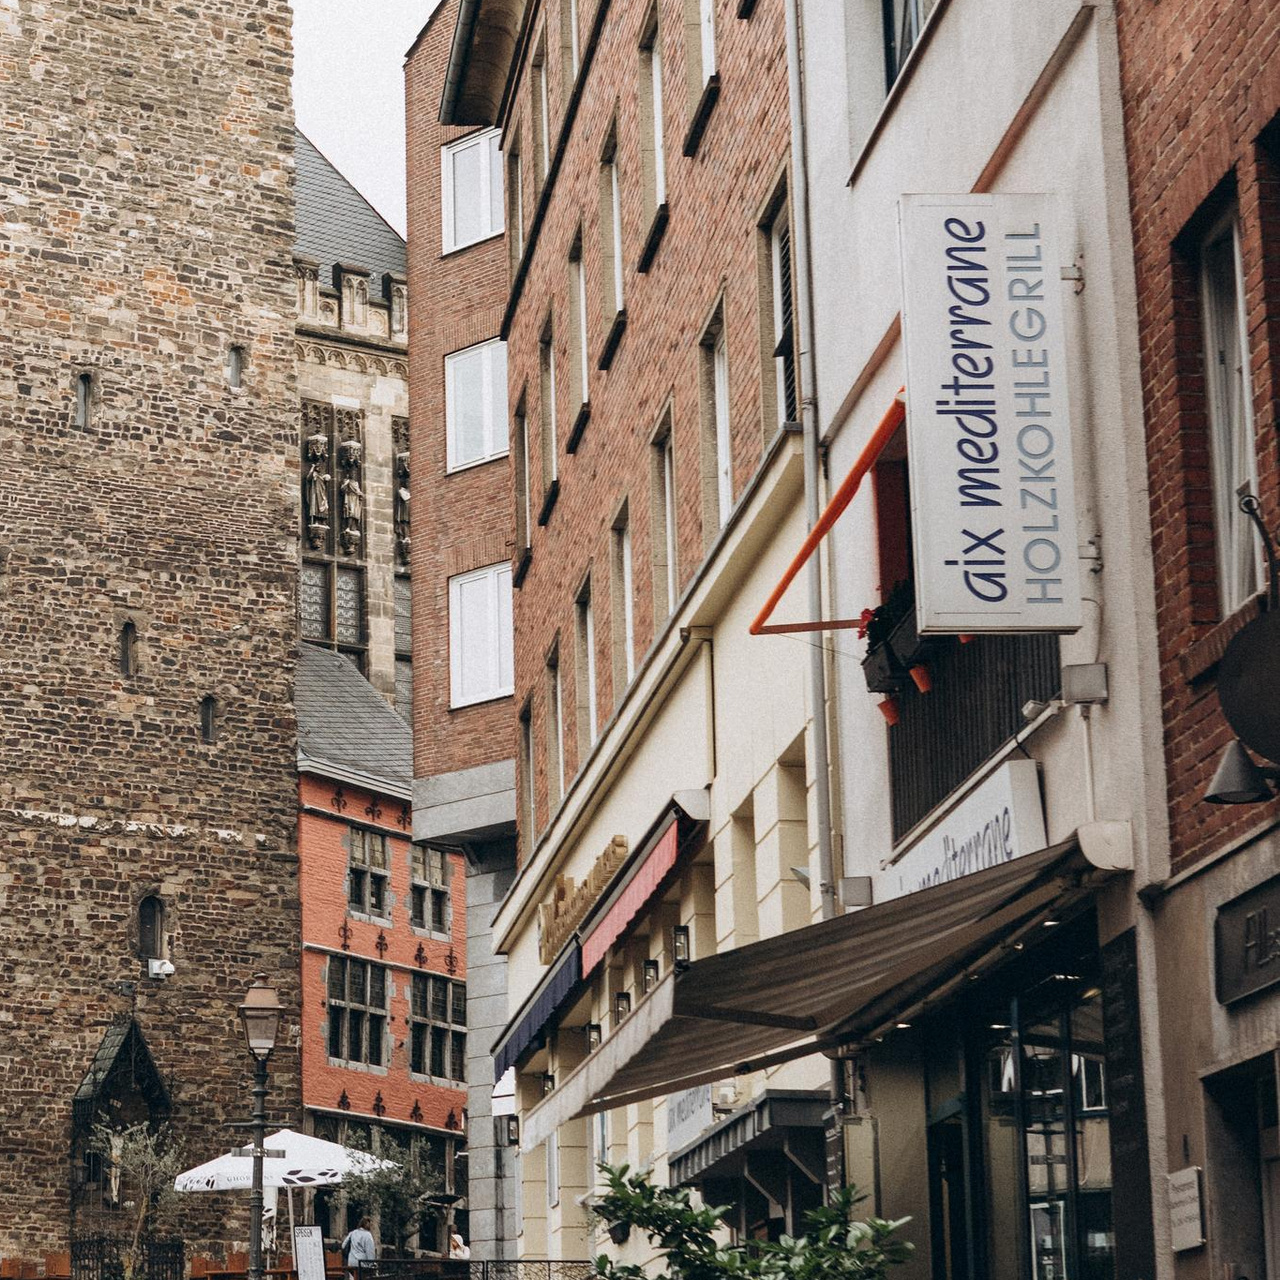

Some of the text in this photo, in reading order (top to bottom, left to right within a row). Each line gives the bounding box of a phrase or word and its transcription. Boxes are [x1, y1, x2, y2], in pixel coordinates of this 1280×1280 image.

[936, 217, 1007, 603] aix mediterrane
[1005, 223, 1063, 605] HOLZKOHLEGRILL
